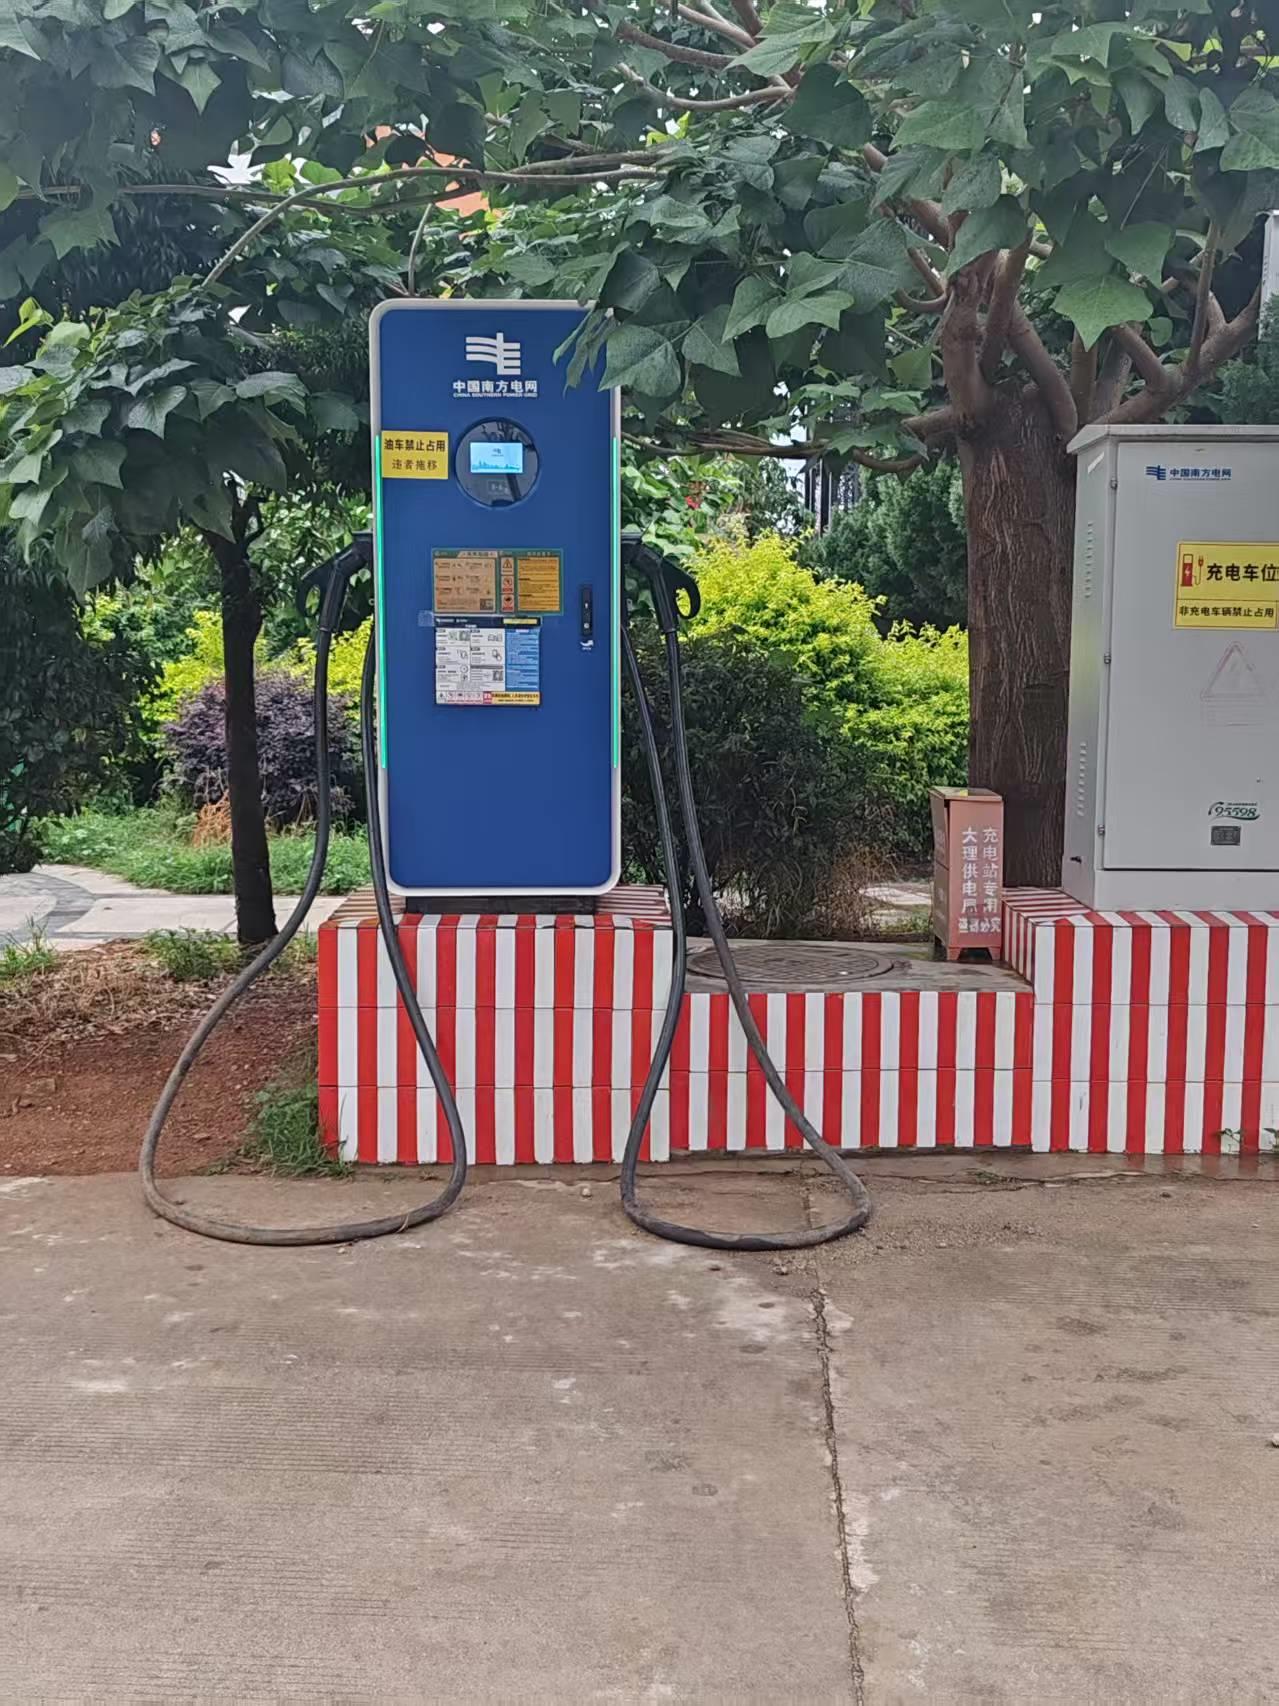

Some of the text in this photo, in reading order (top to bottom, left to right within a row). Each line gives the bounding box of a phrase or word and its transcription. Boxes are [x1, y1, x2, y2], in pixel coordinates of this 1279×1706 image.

[453, 380, 538, 393] 中国南方电网
[384, 438, 446, 452] 油车禁止占用
[391, 458, 438, 471] 违者拖移
[1169, 468, 1232, 478] 中国南方电网
[1207, 563, 1279, 582] 充电车位
[1179, 605, 1275, 618] 非充电车辆禁止占用
[1214, 806, 1257, 818] 95598
[961, 826, 978, 913] 大理供电局
[982, 826, 999, 913] 充电站专用
